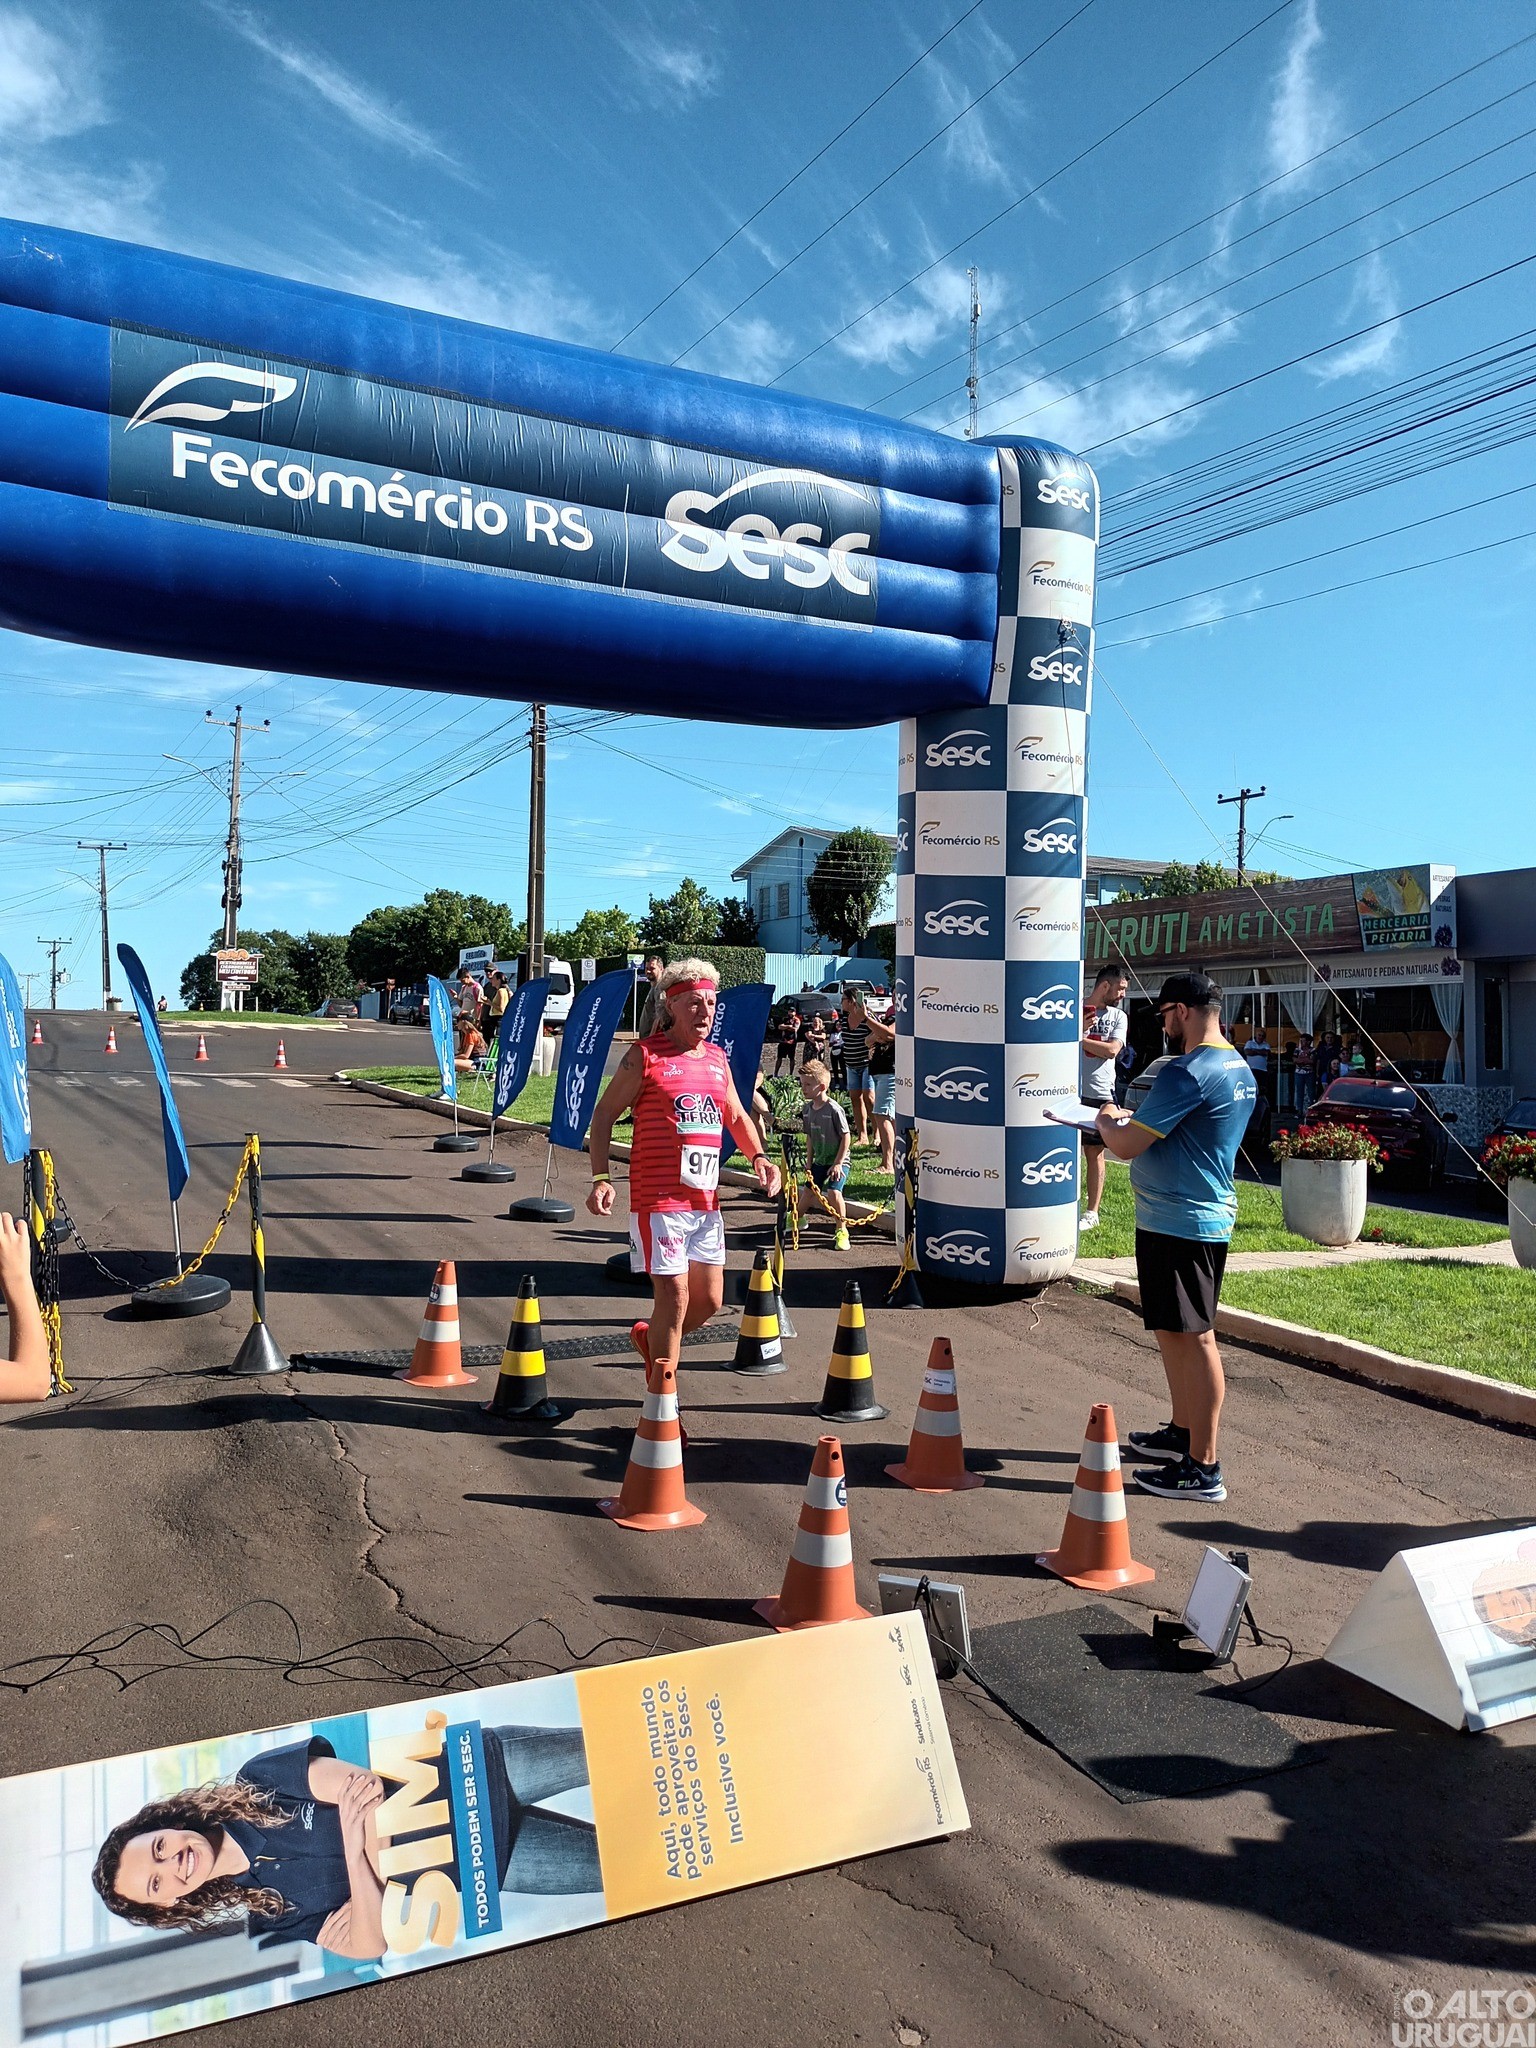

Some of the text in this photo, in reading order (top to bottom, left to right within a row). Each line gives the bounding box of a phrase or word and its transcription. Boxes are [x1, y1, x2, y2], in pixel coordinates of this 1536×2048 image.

[172, 431, 594, 552] Fecomércio RS
[1037, 479, 1090, 513] Sesc
[661, 488, 870, 596] Sesc
[1033, 575, 1092, 596] Fecomércio RS
[1028, 656, 1083, 686] Sesc
[925, 743, 991, 767] Sesc
[1021, 750, 1083, 766] Fecomércio RS
[922, 834, 1000, 846] Fecomércio RS
[1022, 828, 1077, 854] Sesc
[924, 911, 989, 936] Sesc
[1019, 920, 1079, 932] Fecomércio RS
[1085, 903, 1334, 959] TIFRUTI AMETISTA
[1363, 915, 1429, 930] MERCEARIA
[1371, 930, 1426, 944] PEIXARIA
[1332, 964, 1439, 979] ARTESANATO E PEDRAS NATURAIS
[509, 991, 526, 1042] Fecomércio
[921, 999, 999, 1014] Fecomércio RS
[1020, 996, 1075, 1021] Sesc
[515, 1016, 526, 1043] Senac
[576, 996, 602, 1054] Fecomércio
[585, 1023, 602, 1055] Senac
[568, 1063, 588, 1131] Sesc
[923, 1074, 989, 1102] Sesc
[1018, 1084, 1077, 1098] Fecomércio RS
[922, 1161, 1000, 1180] Fecomércio RS
[1021, 1160, 1073, 1185] Sesc
[925, 1237, 991, 1266] Sesc
[1019, 1247, 1068, 1261] Fecomércio
[1177, 1479, 1201, 1489] FILA
[911, 1698, 925, 1745] Sindicatos
[676, 1686, 714, 1866] serviços do Sesc.
[706, 1692, 744, 1844] Inclusive você.
[924, 1757, 930, 1770] RS
[641, 1686, 682, 1879] Aqui, todo mundo
[658, 1679, 702, 1880] pode aproveitar os
[927, 1771, 944, 1825] Fecomércio
[459, 1729, 489, 1928] TODOS PODEM SER SESC.
